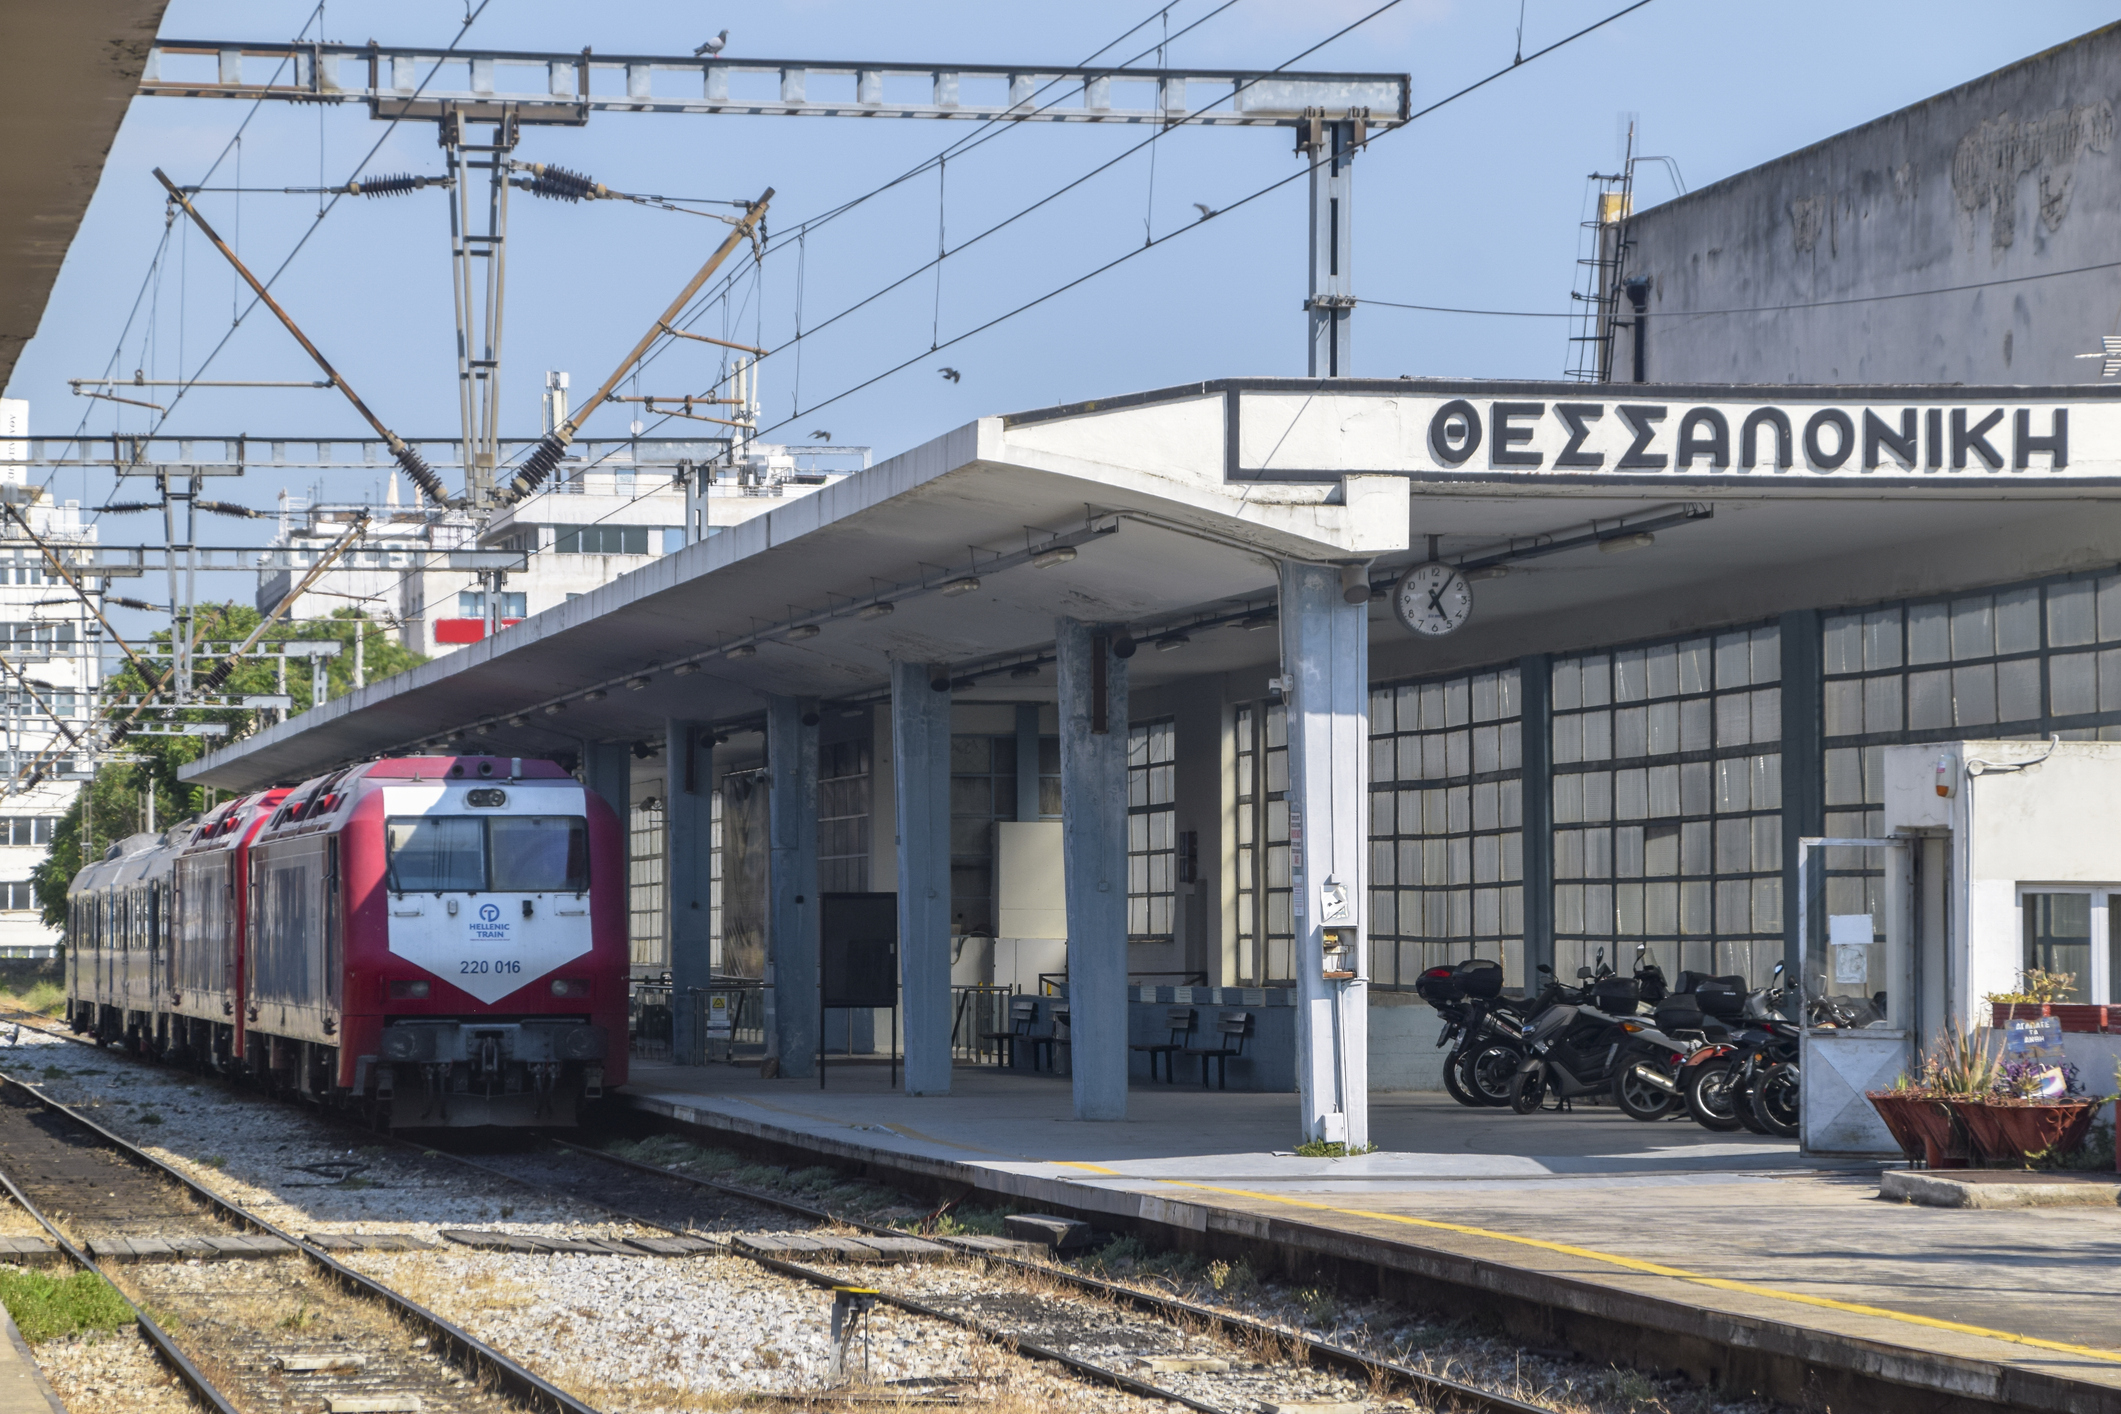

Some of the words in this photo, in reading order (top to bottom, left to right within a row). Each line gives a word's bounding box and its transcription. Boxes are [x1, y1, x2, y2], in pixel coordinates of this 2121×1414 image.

[1428, 400, 2069, 473] ΘΕΣΣΑΛΟΝΙΚΗ
[1432, 568, 1440, 576] 12
[1408, 581, 1415, 590] 10
[1456, 582, 1463, 591] 2
[1404, 595, 1411, 604] 9
[1461, 596, 1467, 605] 3
[1408, 609, 1414, 618] 8
[1455, 610, 1462, 618] 4
[1418, 620, 1424, 628] 7
[1432, 624, 1438, 632] 6
[1446, 620, 1452, 629] 5
[460, 960, 489, 974] 220
[494, 960, 521, 974] 016
